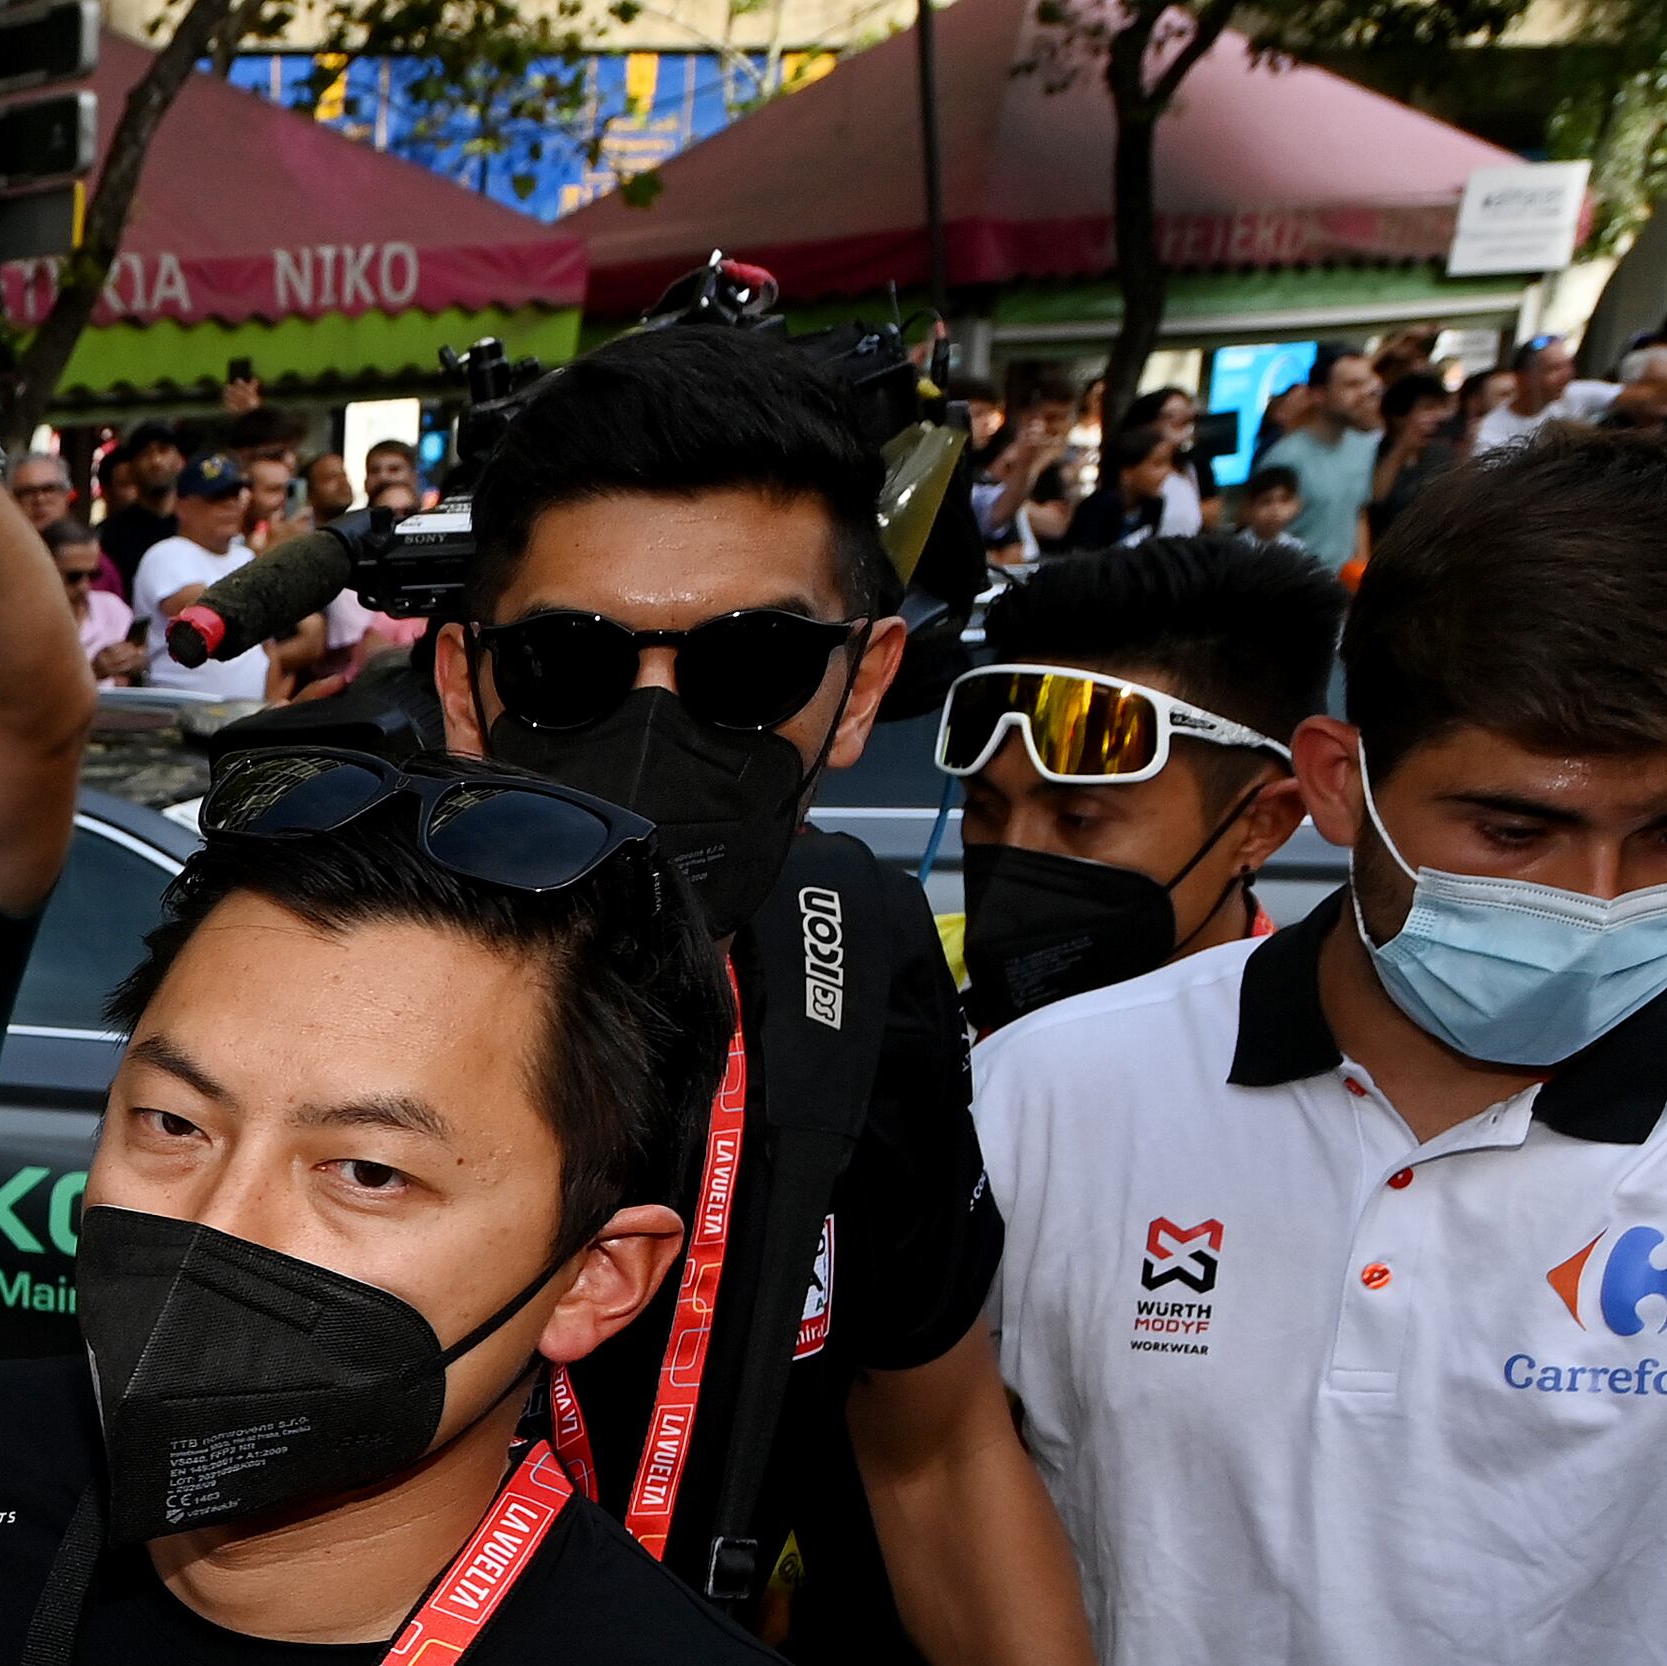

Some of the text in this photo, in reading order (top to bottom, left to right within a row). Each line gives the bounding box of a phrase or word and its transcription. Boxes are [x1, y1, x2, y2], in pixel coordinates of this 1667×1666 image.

[274, 243, 421, 304] NIKO
[404, 533, 447, 545] SONY
[704, 1163, 731, 1235] VUELTA
[1137, 1301, 1212, 1319] WÜRTH
[1134, 1318, 1210, 1334] MODYF
[1130, 1340, 1209, 1355] WORKWEAR
[171, 1439, 198, 1450] TTB
[170, 1467, 186, 1478] EN
[642, 1435, 679, 1506] VUELTA
[451, 1533, 521, 1612] VUELTA
